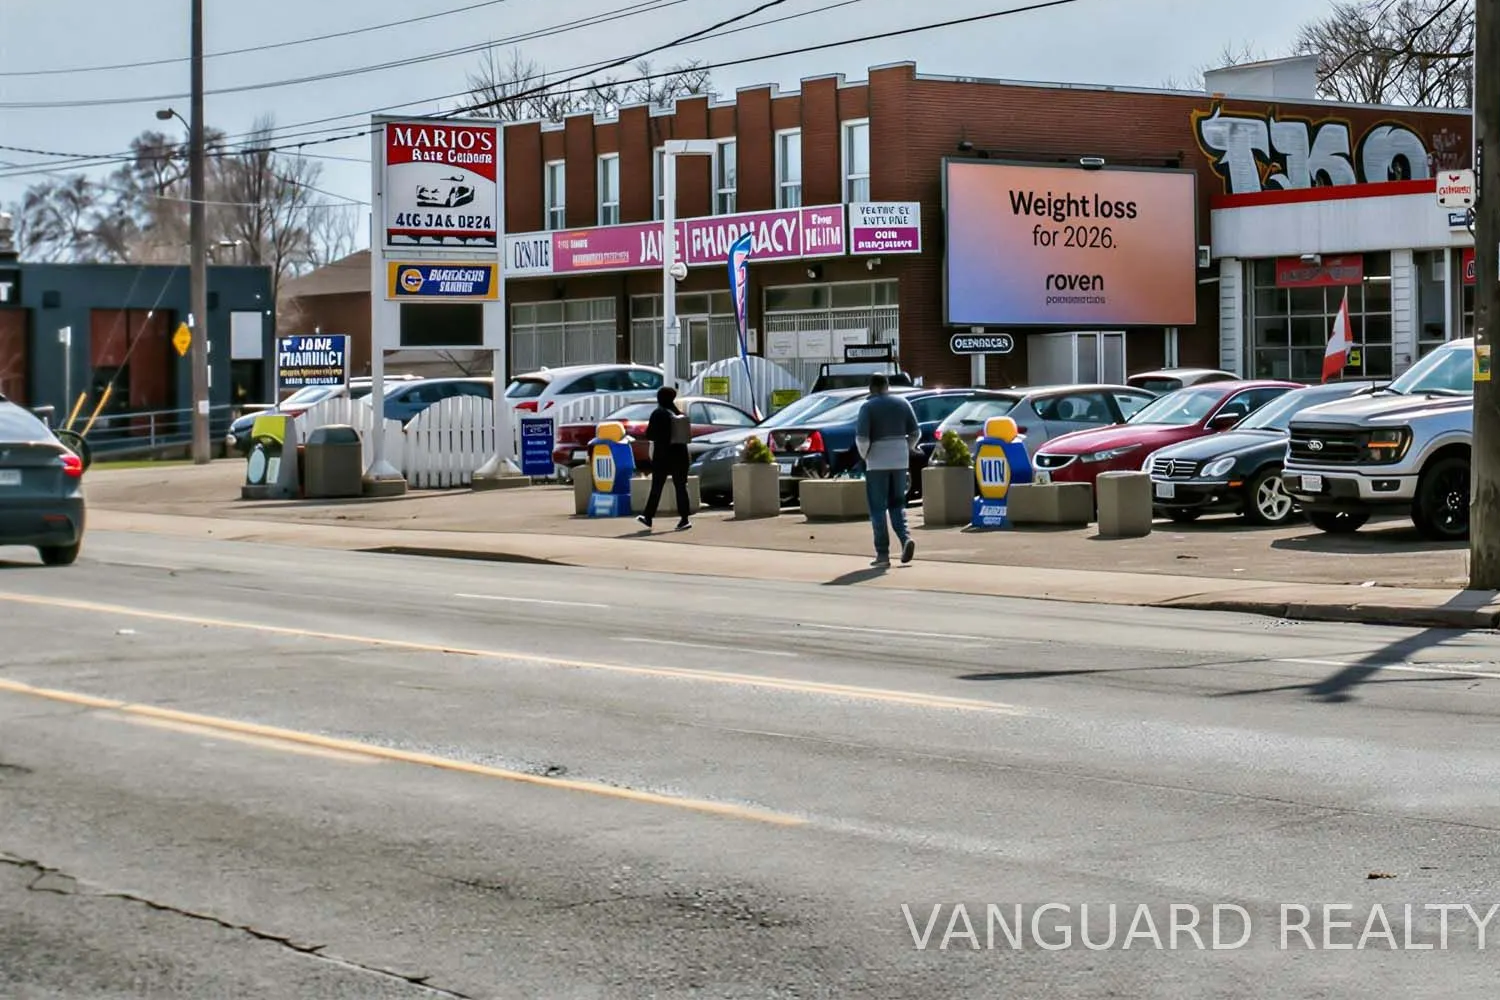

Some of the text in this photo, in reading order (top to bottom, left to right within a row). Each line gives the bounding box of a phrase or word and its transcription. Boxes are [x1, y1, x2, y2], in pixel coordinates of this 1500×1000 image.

[393, 127, 493, 151] MARIO'S
[1009, 190, 1137, 222] Weight loss
[639, 228, 682, 263] JAE
[1032, 224, 1117, 249] for 2026.
[1046, 274, 1104, 291] roven
